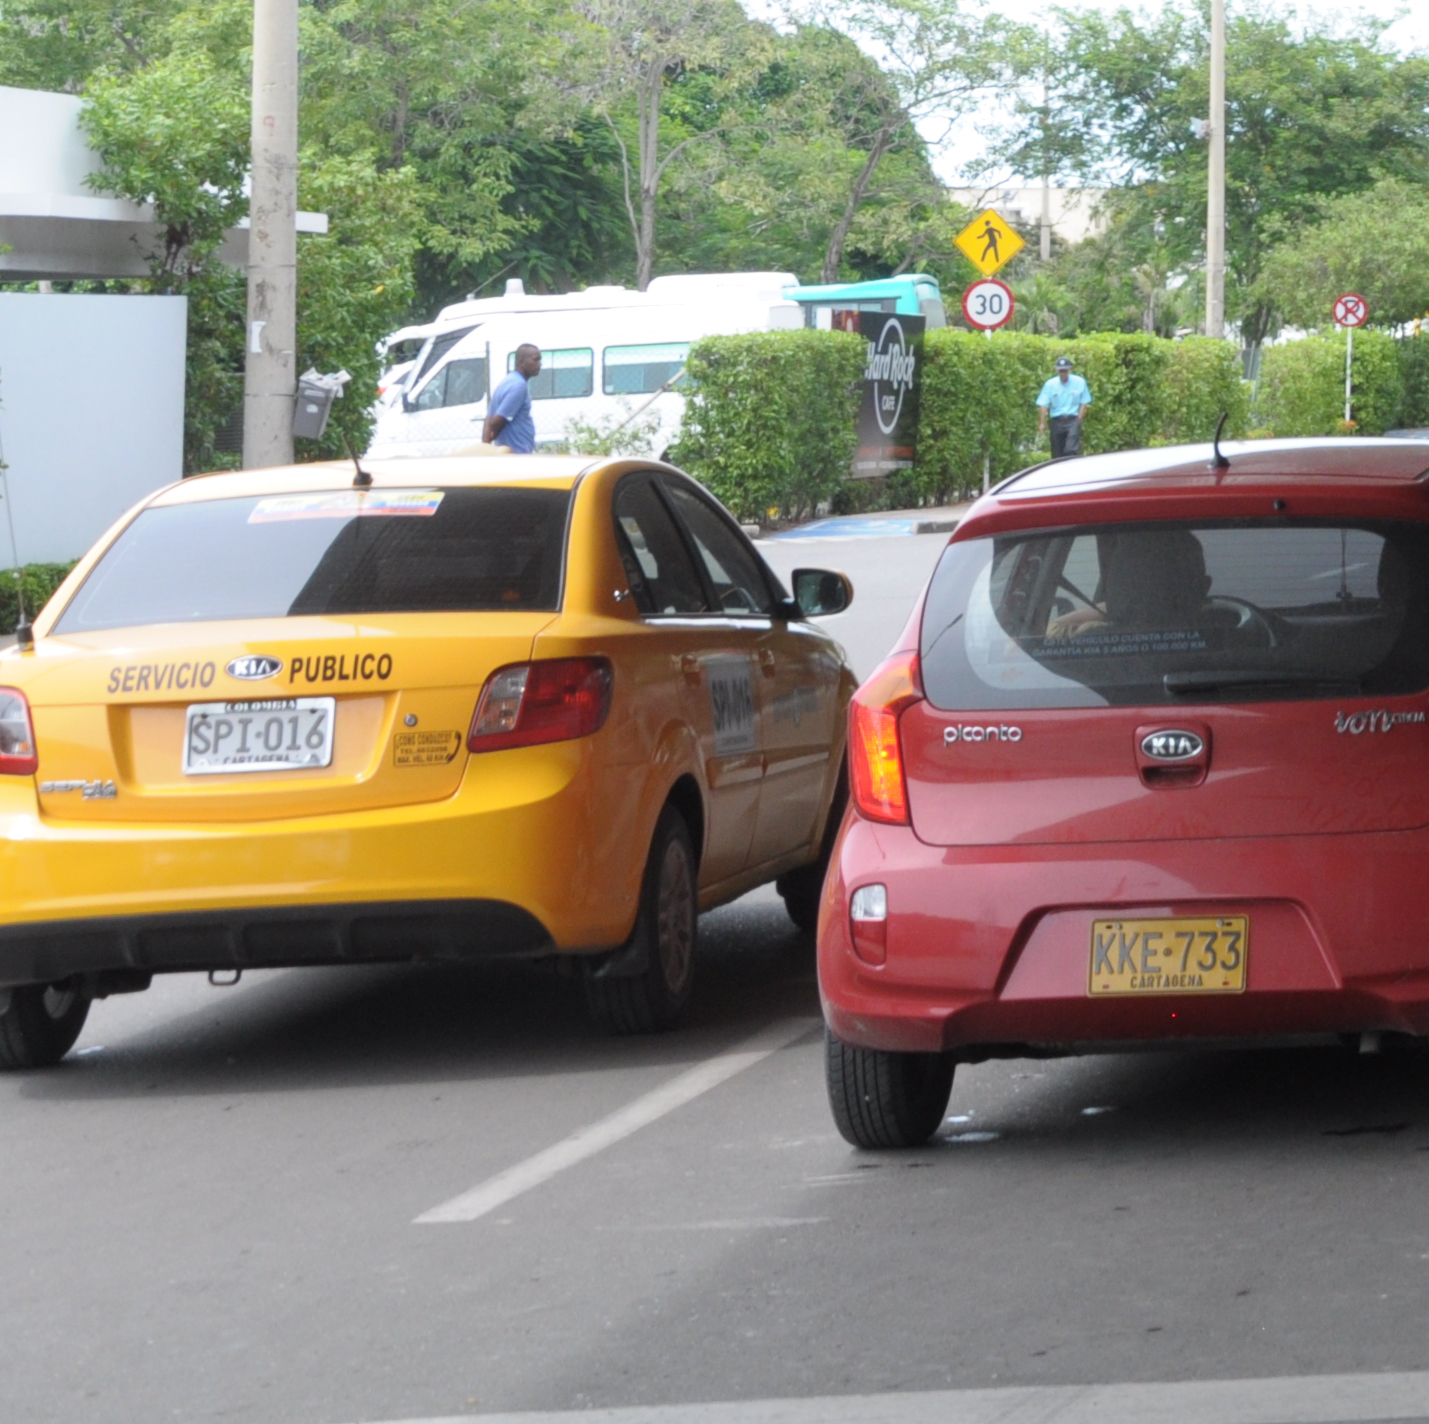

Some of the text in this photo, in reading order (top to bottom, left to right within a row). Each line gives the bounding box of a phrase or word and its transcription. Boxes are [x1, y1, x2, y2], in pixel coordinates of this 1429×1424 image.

[974, 293, 1003, 315] 30
[865, 342, 915, 390] Hard Rock
[882, 395, 896, 411] CAFE
[1163, 631, 1185, 641] CON
[1187, 631, 1200, 639] LA
[1084, 646, 1101, 654] KIA
[1190, 640, 1206, 649] KM
[234, 659, 273, 676] KIA
[289, 653, 393, 684] PUBLICO
[107, 660, 216, 694] SERVICIO
[226, 699, 296, 713] COLOMBIA
[943, 724, 1023, 746] picanto
[1150, 736, 1192, 755] KIA
[223, 753, 290, 764] CARTAGENA
[1130, 974, 1203, 989] CARTAGENA
